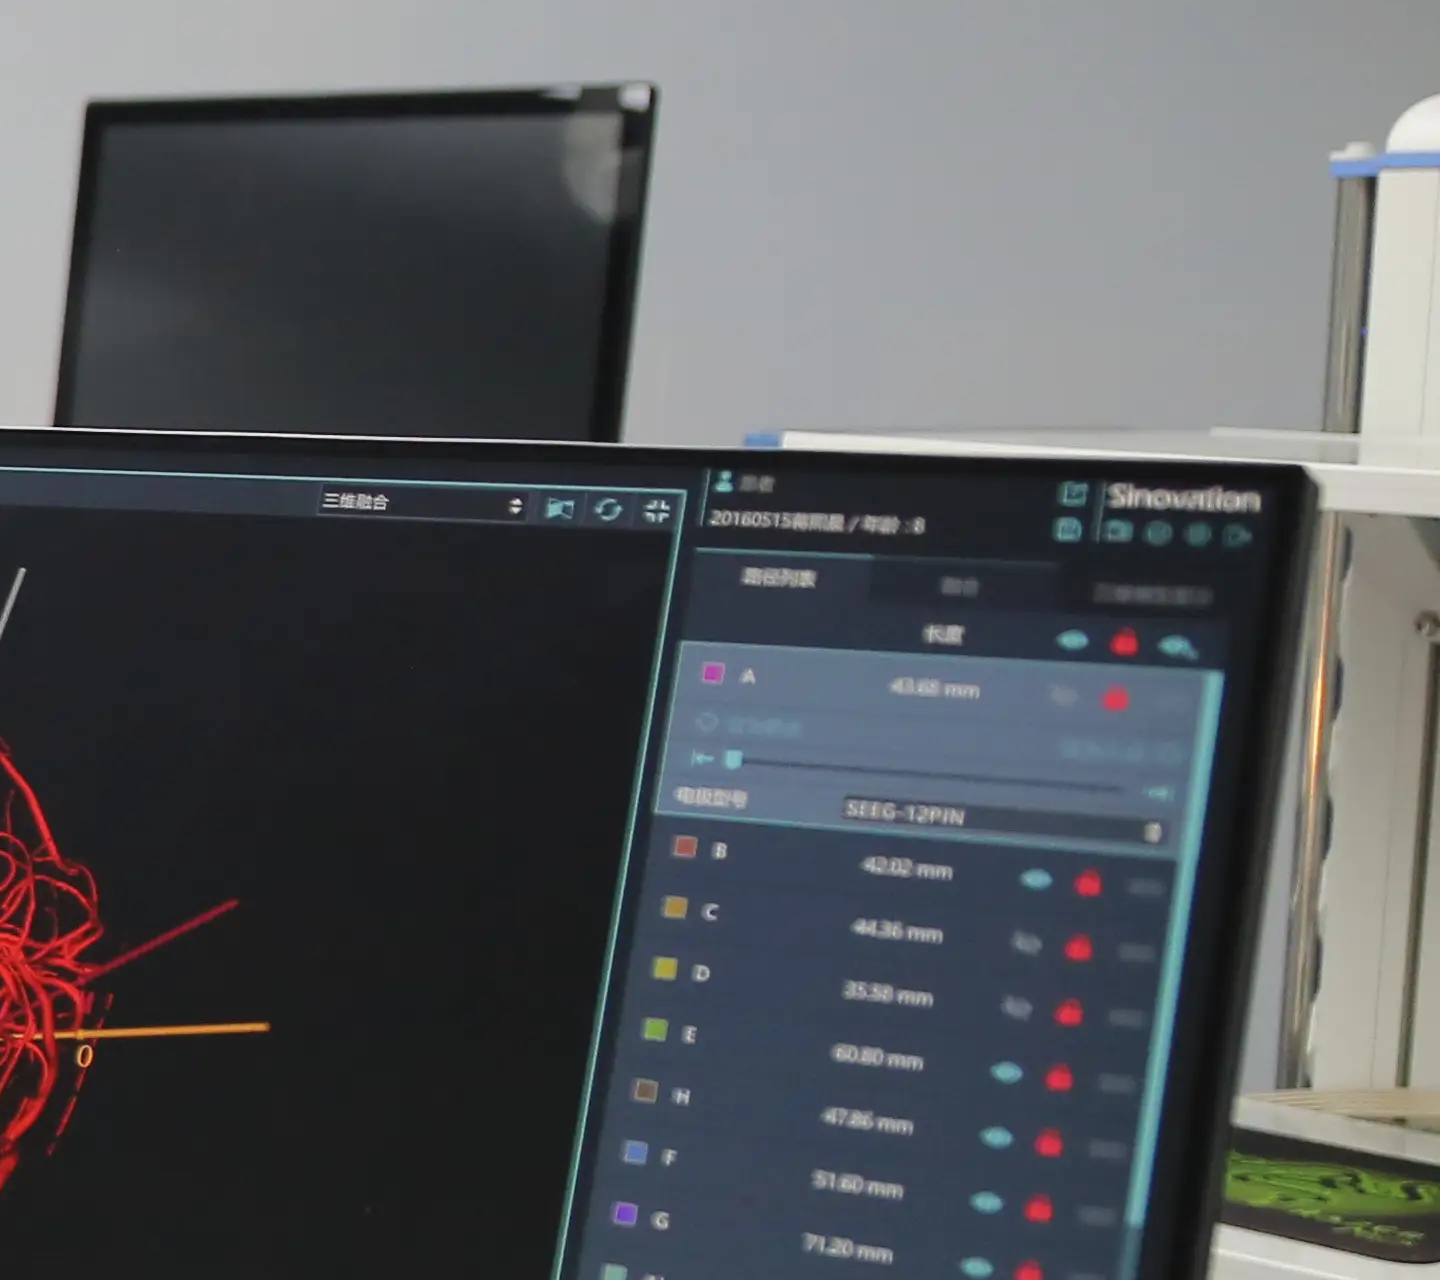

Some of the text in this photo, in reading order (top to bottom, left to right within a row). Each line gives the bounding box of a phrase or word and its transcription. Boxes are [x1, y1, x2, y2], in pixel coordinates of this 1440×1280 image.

[323, 491, 390, 512] 三维融合
[1107, 482, 1262, 513] Sinovation
[709, 508, 845, 533] 20160515
[922, 624, 966, 646] 长度
[740, 668, 757, 686] A
[944, 683, 980, 701] mm
[711, 841, 728, 859] B
[916, 862, 954, 881] mm
[701, 902, 721, 921] C
[906, 924, 943, 944] mm
[691, 963, 711, 982] D
[896, 987, 934, 1007] mm
[682, 1024, 698, 1044] E
[886, 1050, 924, 1071] mm
[877, 1114, 914, 1135] mm
[867, 1178, 905, 1200] mm
[855, 1243, 894, 1265] mm
